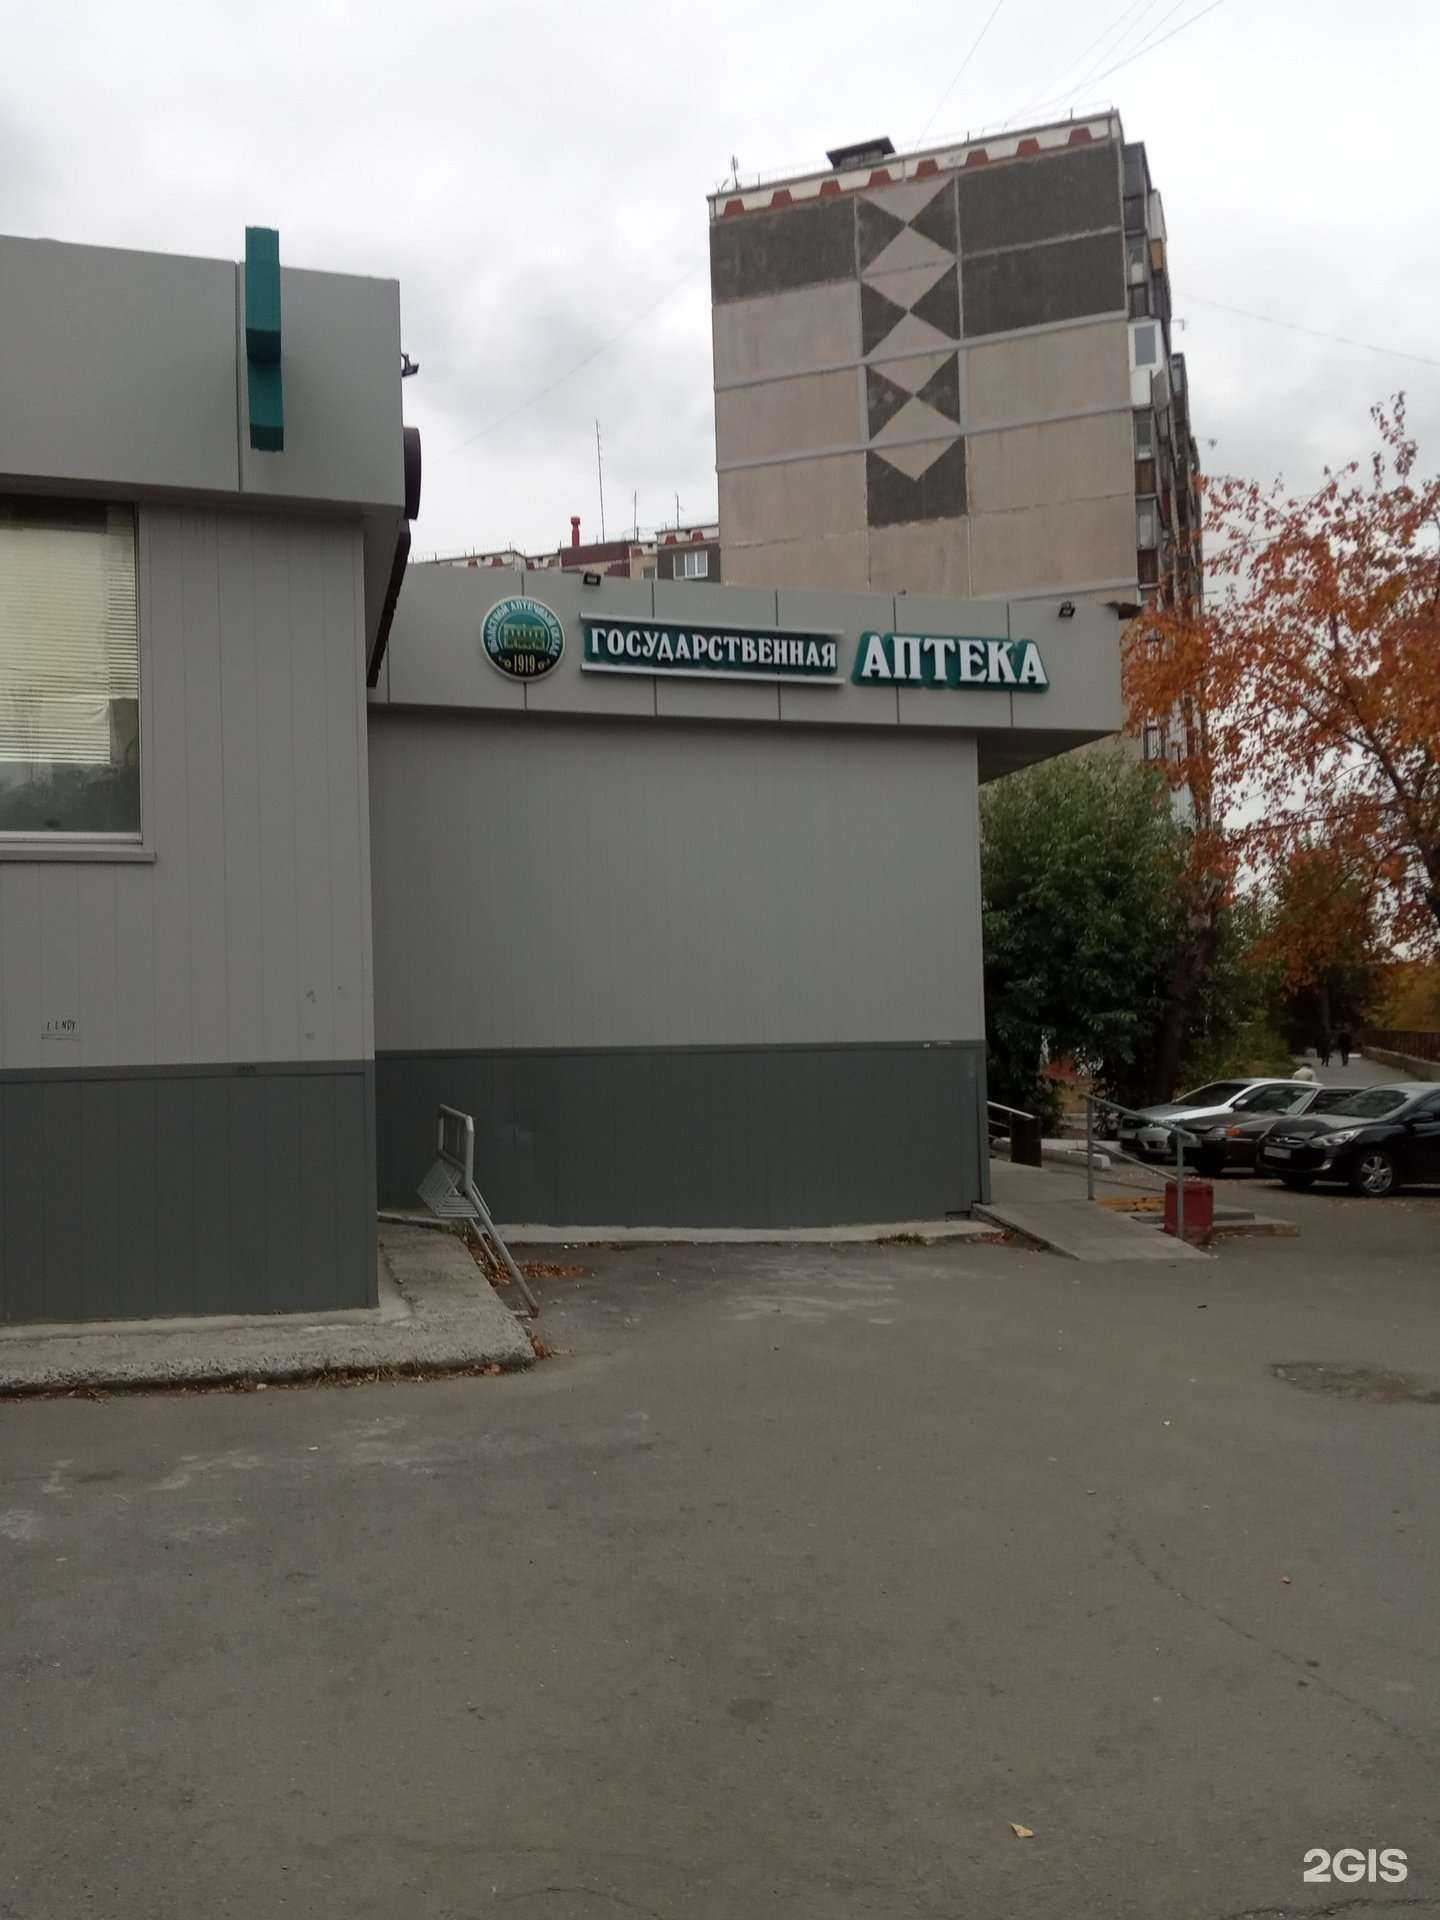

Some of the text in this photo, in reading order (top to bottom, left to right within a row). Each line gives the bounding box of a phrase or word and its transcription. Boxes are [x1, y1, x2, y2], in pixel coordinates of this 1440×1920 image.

[514, 654, 536, 673] 1919
[590, 628, 1048, 685] ГОСУДАРСТВЕННАЯ АПТЕКА
